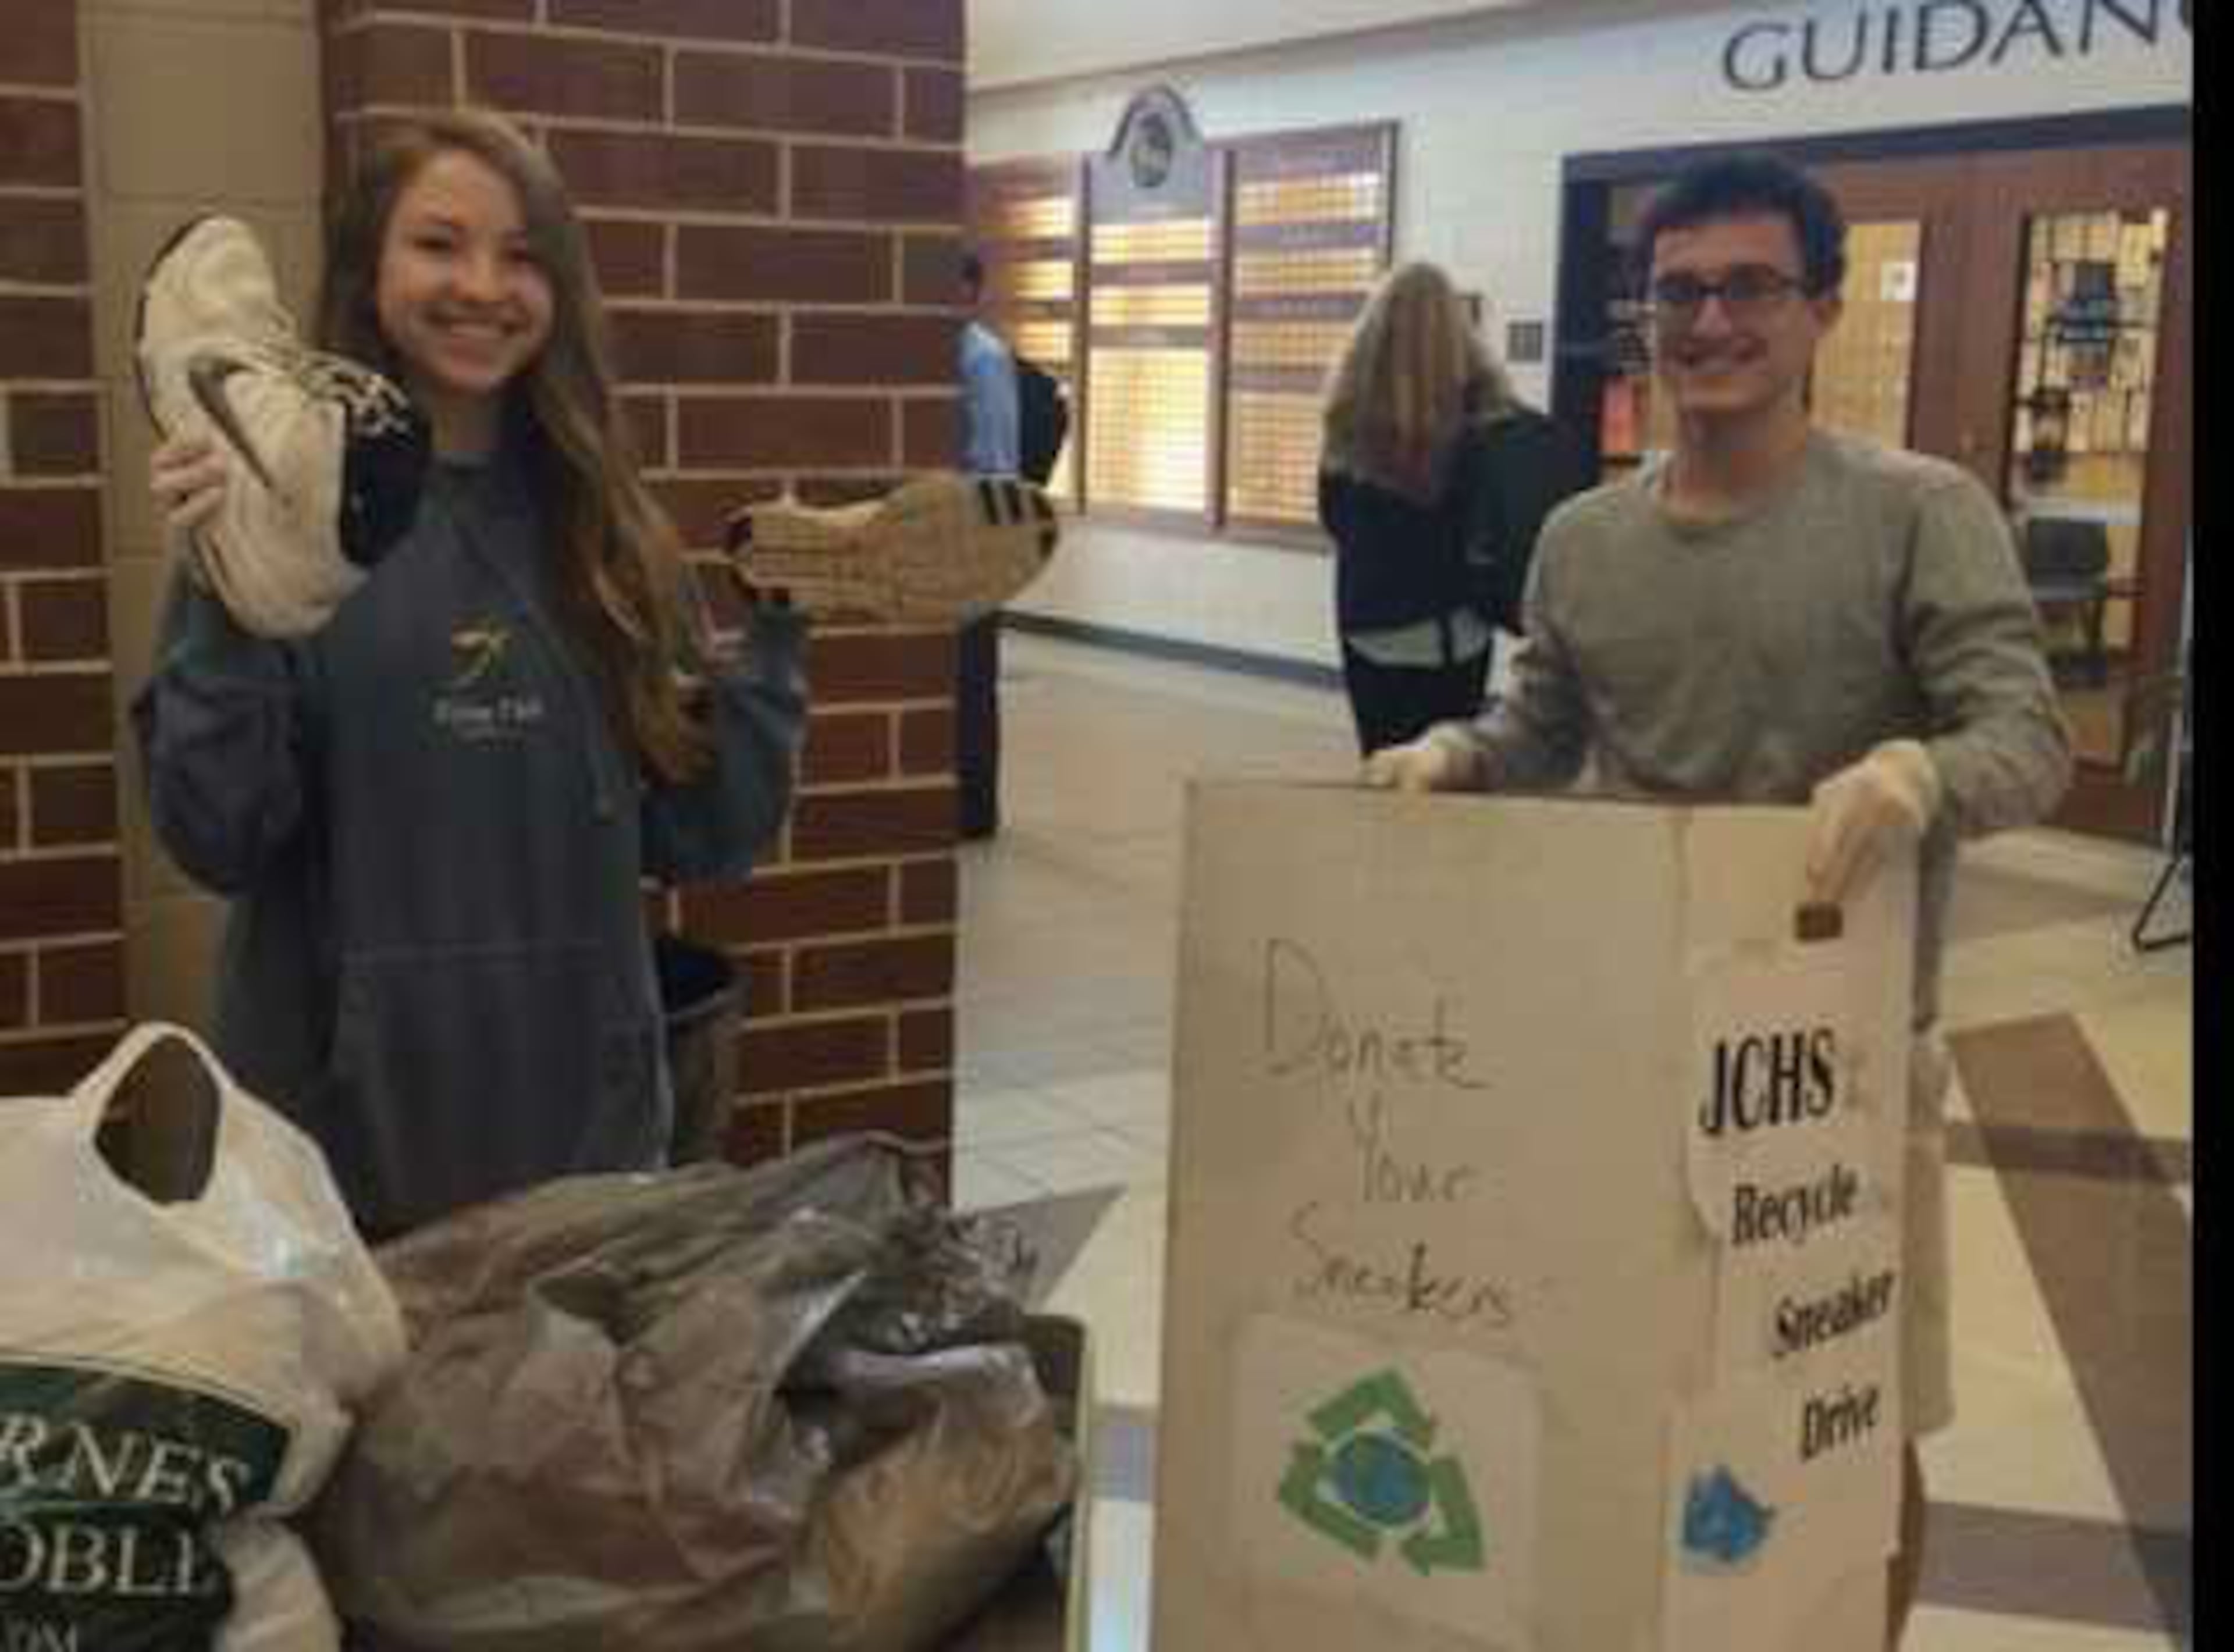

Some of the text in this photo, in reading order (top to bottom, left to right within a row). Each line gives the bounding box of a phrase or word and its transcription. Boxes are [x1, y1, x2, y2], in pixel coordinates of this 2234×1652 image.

[1722, 0, 2193, 91] GUIDAN
[1262, 935, 1490, 1090] Donate
[1698, 1026, 1835, 1138] JCHS
[1345, 1089, 1481, 1202] Your
[1731, 1163, 1859, 1247] Recycle
[1772, 1269, 1894, 1359] Sneaker
[1801, 1384, 1880, 1461] Drive
